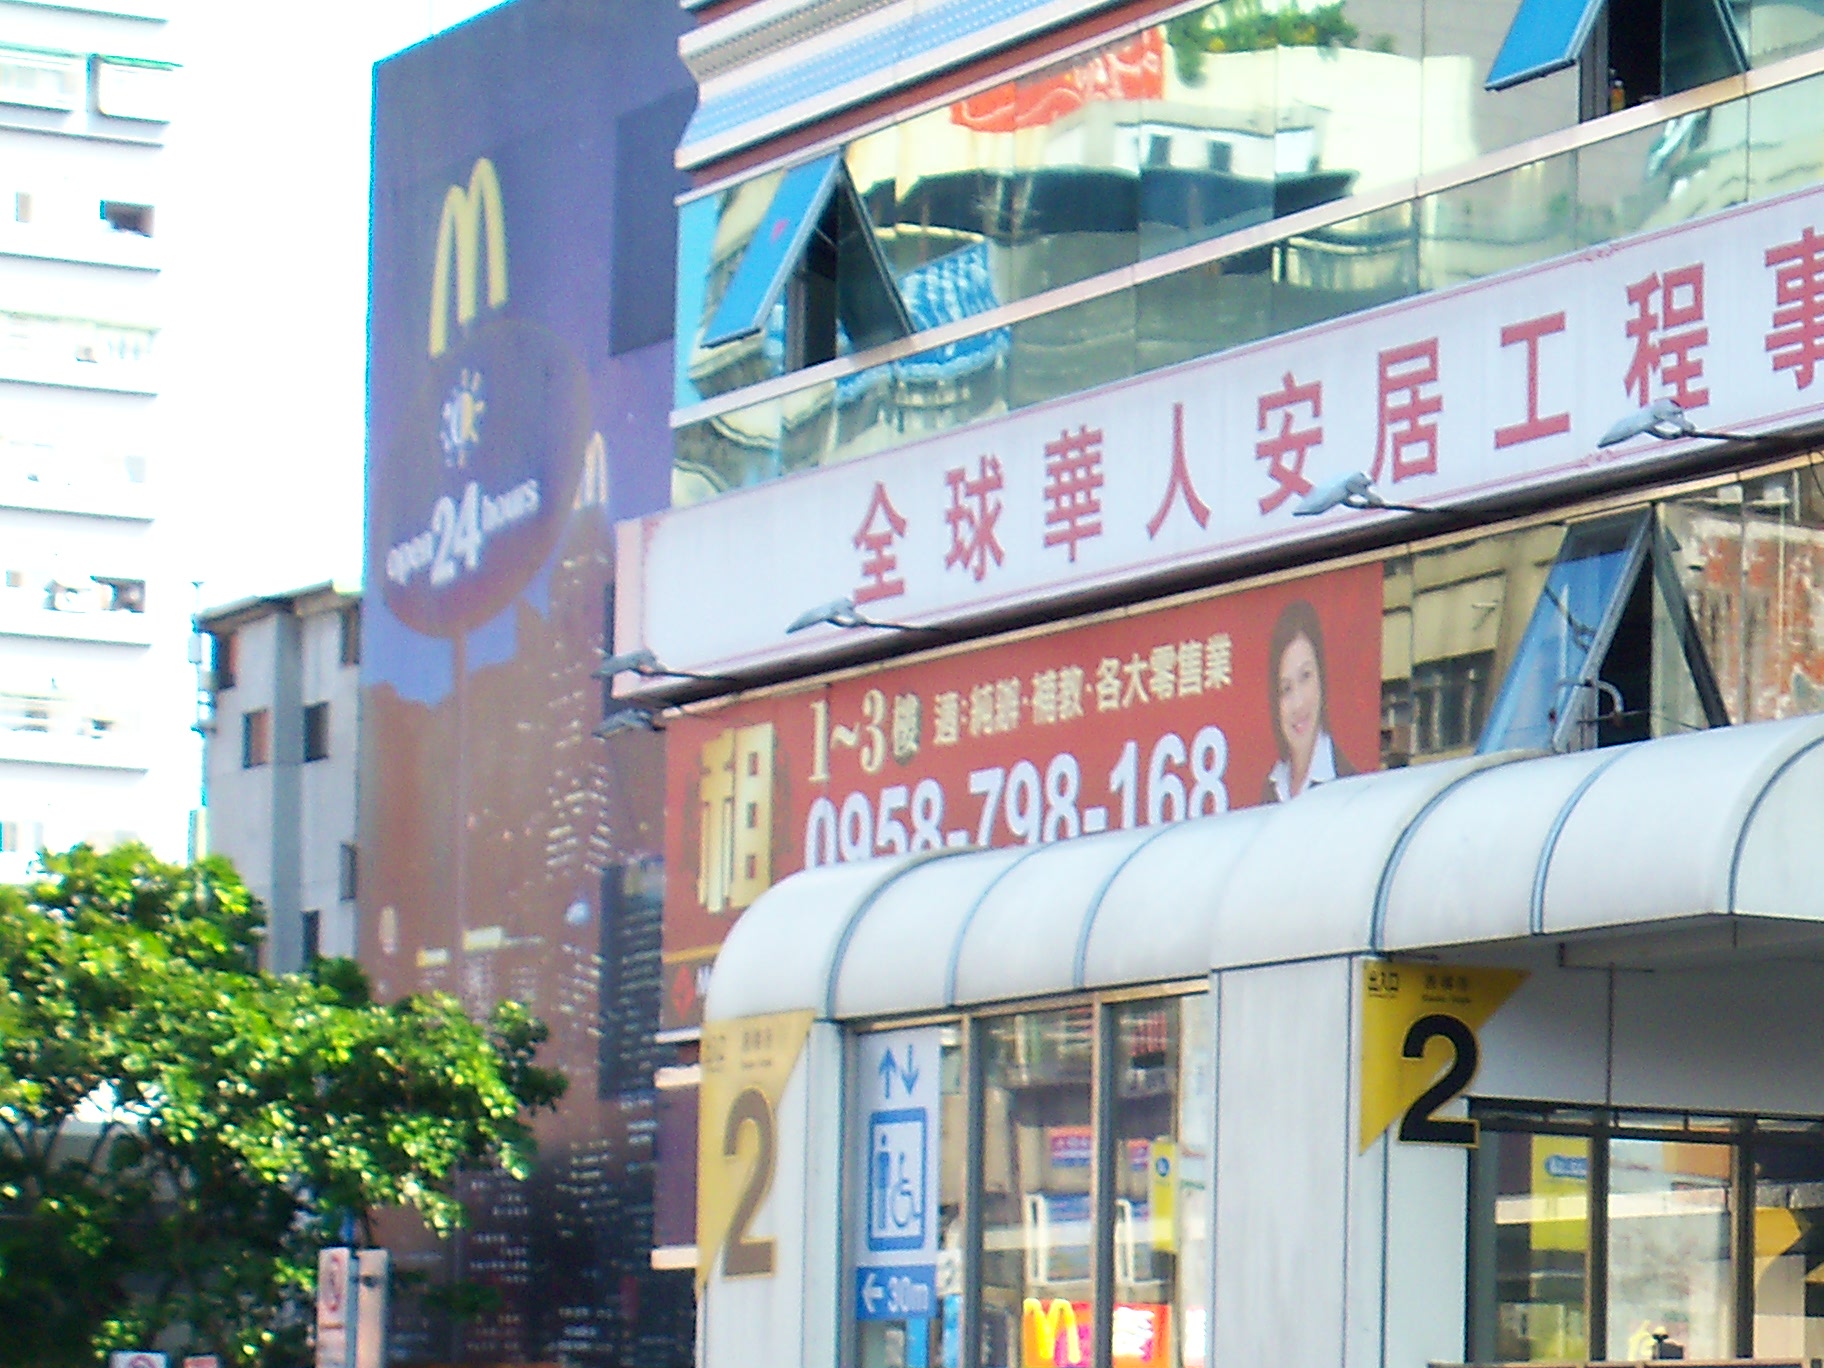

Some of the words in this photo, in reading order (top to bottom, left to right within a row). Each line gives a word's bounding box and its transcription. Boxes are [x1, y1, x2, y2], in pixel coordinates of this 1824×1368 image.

[430, 481, 482, 586] 24
[482, 478, 541, 532] hours
[697, 721, 775, 914] 租
[804, 725, 1229, 870] 0958-798-168
[1399, 1013, 1479, 1148] 2
[723, 1087, 778, 1280] 2
